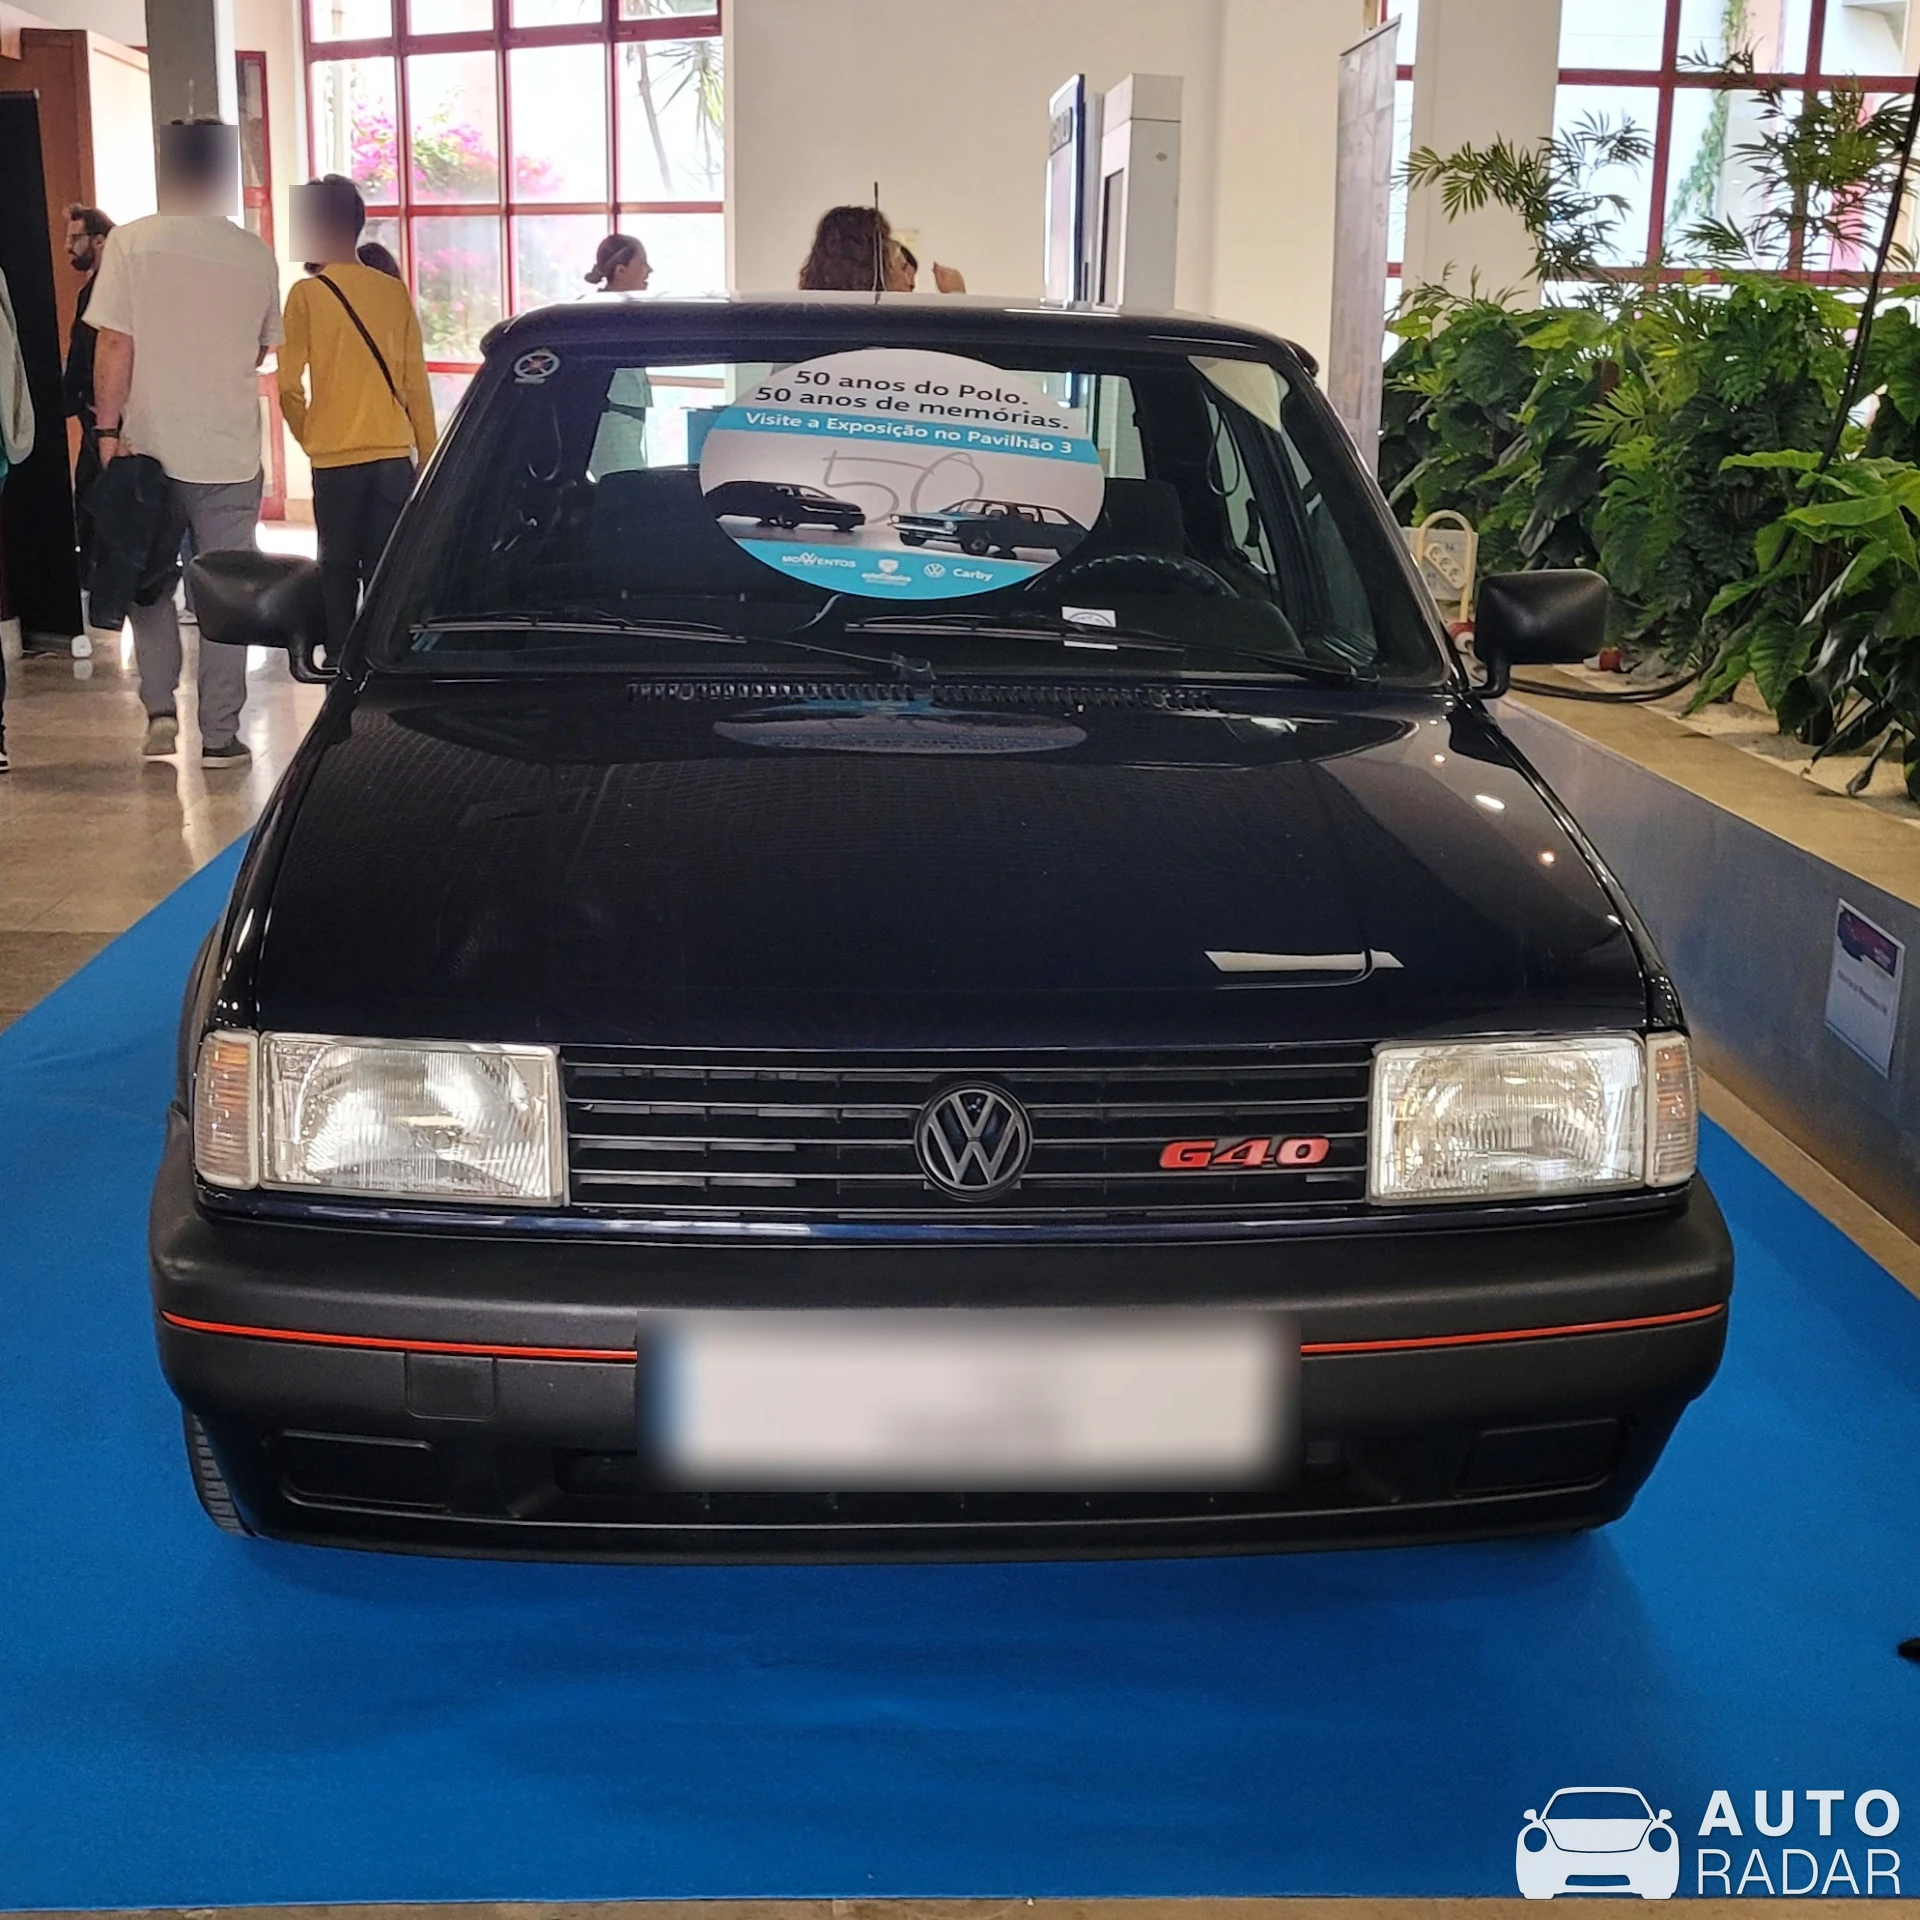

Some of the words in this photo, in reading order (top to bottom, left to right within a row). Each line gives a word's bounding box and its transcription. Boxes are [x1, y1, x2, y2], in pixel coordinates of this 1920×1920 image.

[794, 370, 830, 386] 50
[838, 376, 905, 392] anos
[914, 380, 949, 396] do
[958, 384, 1029, 405] Polo.
[755, 387, 791, 402] 50
[799, 393, 868, 408] anos
[876, 396, 910, 411] de
[919, 402, 1069, 429] memórias.
[745, 412, 802, 427] Visite
[807, 418, 820, 429] a
[826, 417, 928, 438] Exposição
[934, 429, 961, 441] no
[968, 431, 1054, 451] Pavilhão
[1060, 441, 1072, 453] 3
[952, 567, 994, 582] Carby
[917, 1084, 1030, 1196] VW
[1159, 1136, 1330, 1169] G40
